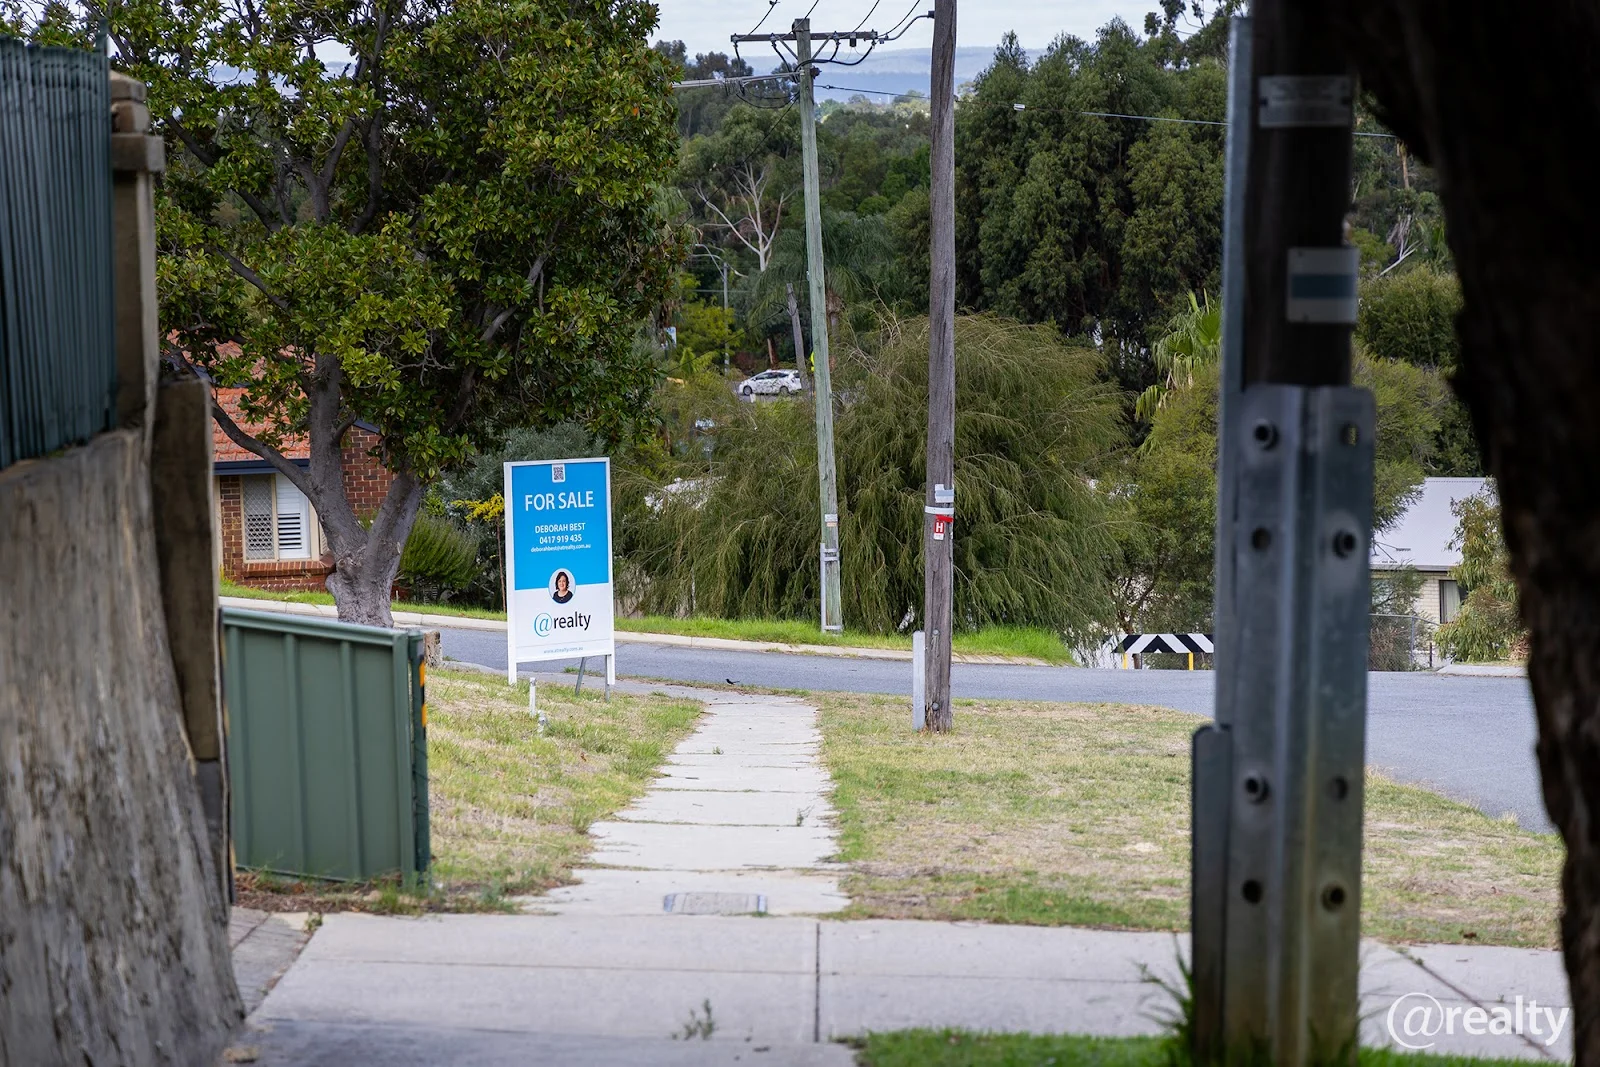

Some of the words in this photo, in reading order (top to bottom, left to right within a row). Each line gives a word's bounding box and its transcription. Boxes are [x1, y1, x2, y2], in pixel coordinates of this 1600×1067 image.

[525, 494, 555, 511] FOR
[558, 491, 594, 509] SALE
[535, 524, 568, 533] DEBORAH
[569, 523, 586, 531] BEST
[935, 522, 944, 533] H
[540, 536, 555, 544] 0417
[557, 535, 569, 543] 919
[570, 534, 582, 542] 435
[534, 611, 591, 637] @realty
